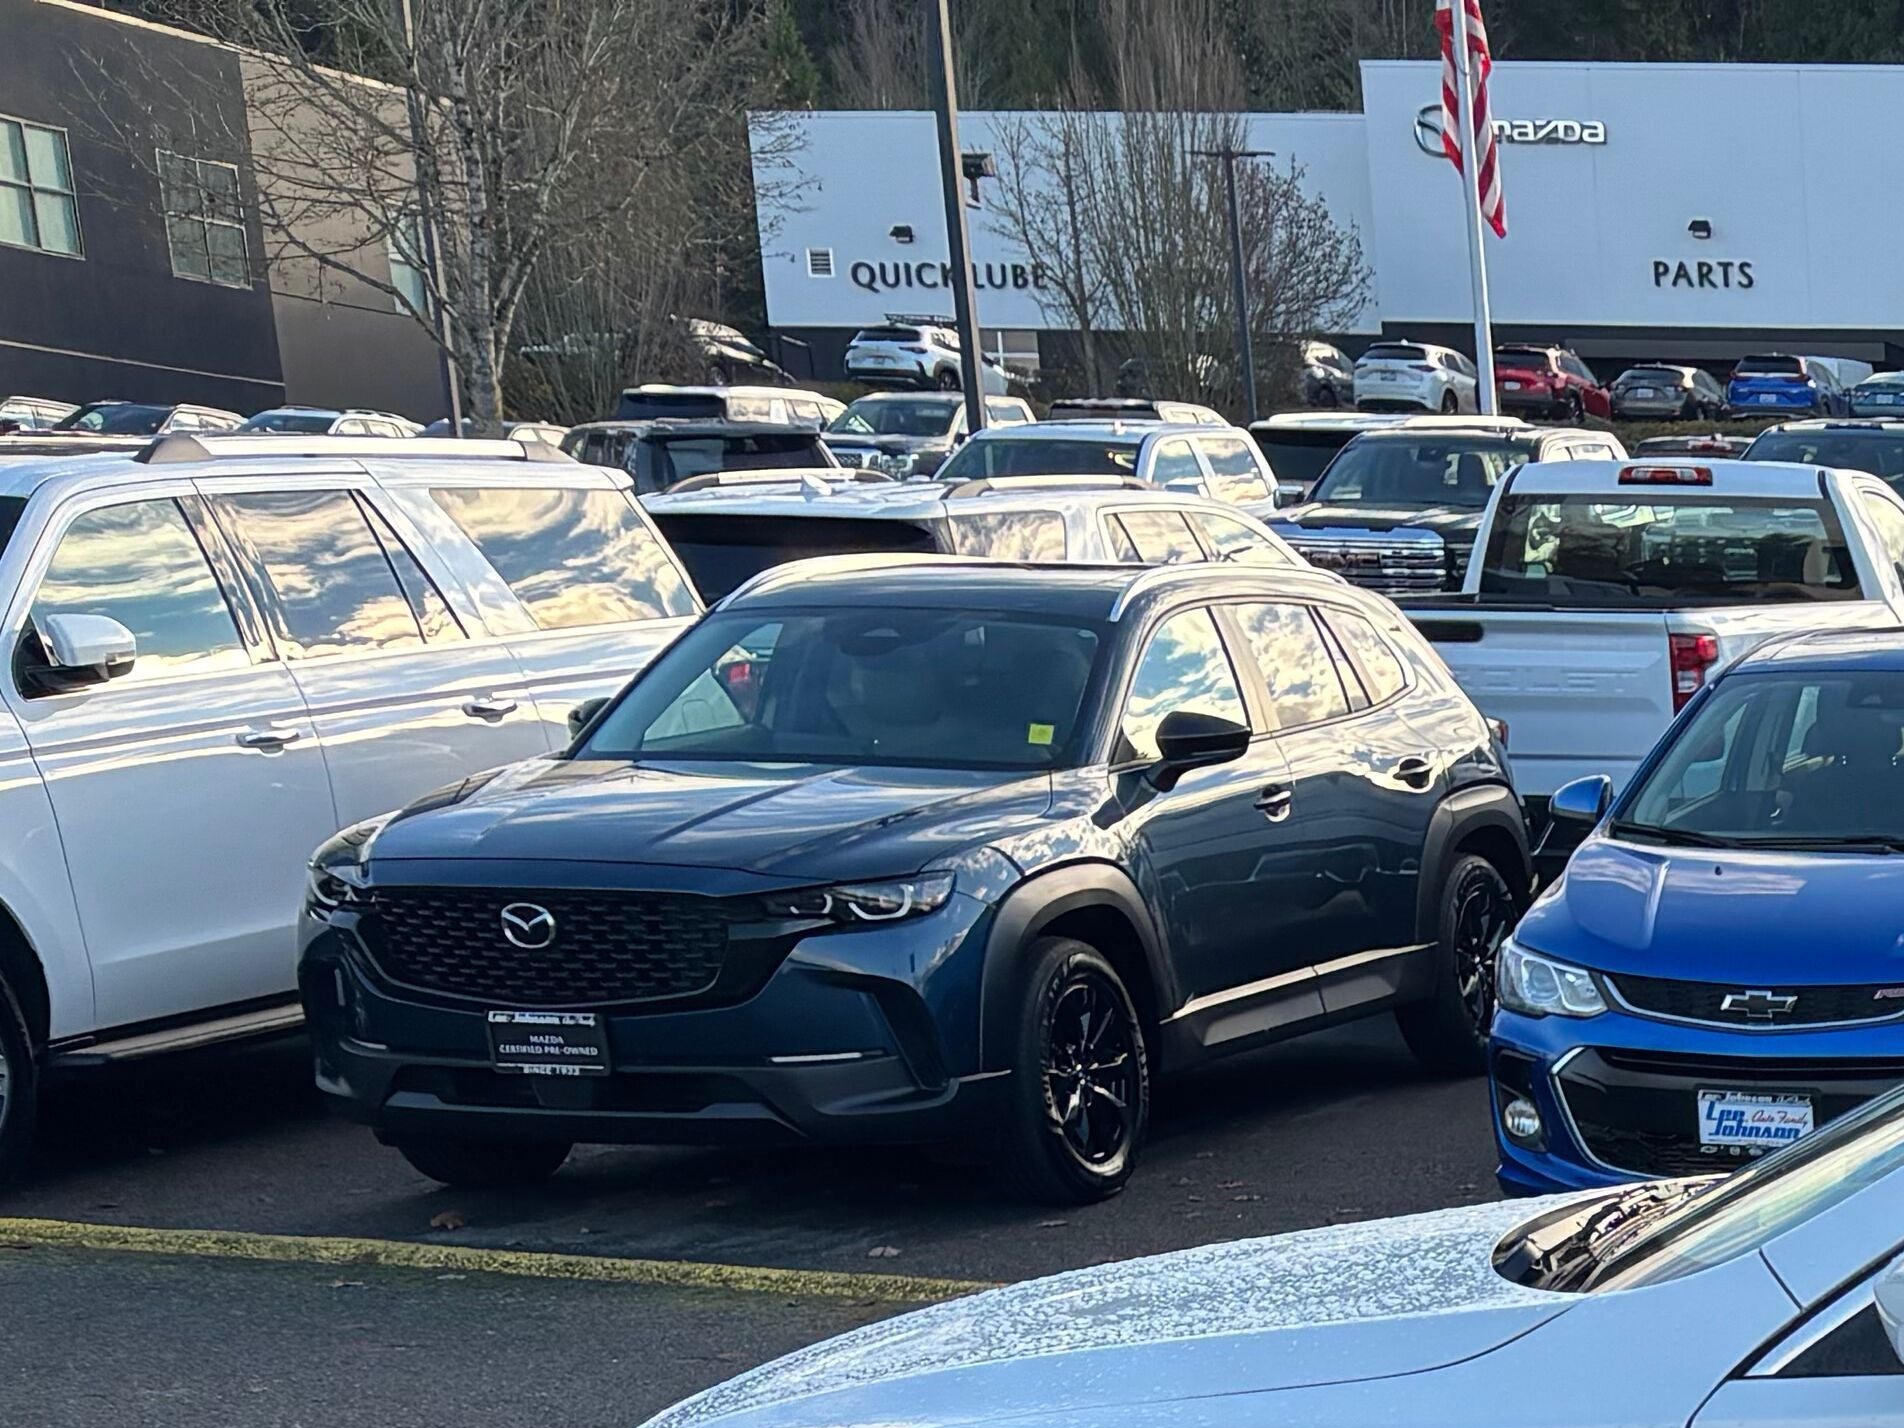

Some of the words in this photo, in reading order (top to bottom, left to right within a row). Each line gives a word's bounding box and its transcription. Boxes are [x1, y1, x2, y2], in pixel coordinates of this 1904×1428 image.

[970, 262, 1050, 290] LUBE
[1653, 260, 1754, 289] PARTS
[529, 1035, 565, 1044] MAZDA
[1705, 1100, 1746, 1121] Lee
[1707, 1119, 1801, 1139] Johnson
